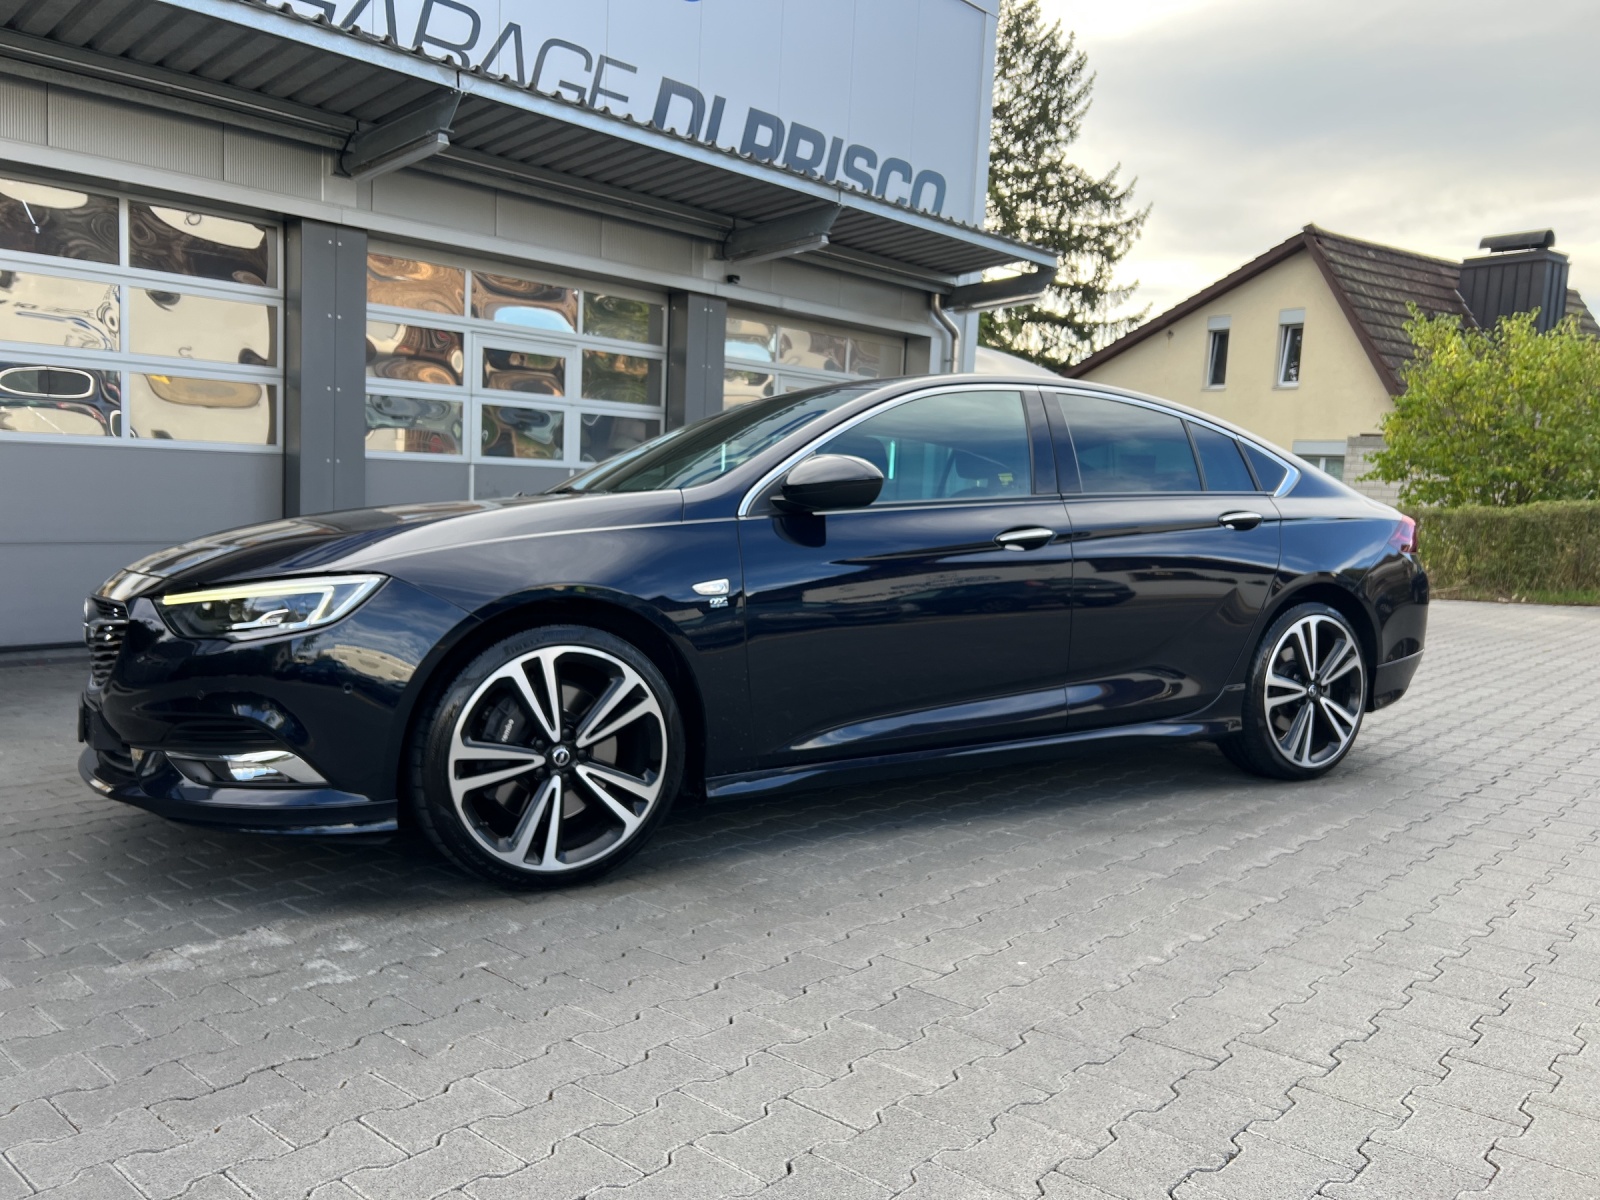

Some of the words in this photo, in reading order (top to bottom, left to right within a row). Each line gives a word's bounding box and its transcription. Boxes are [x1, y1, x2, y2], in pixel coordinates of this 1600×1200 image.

[258, 0, 638, 108] ARAGE
[652, 76, 726, 143] DI
[739, 107, 946, 214] PRISCO
